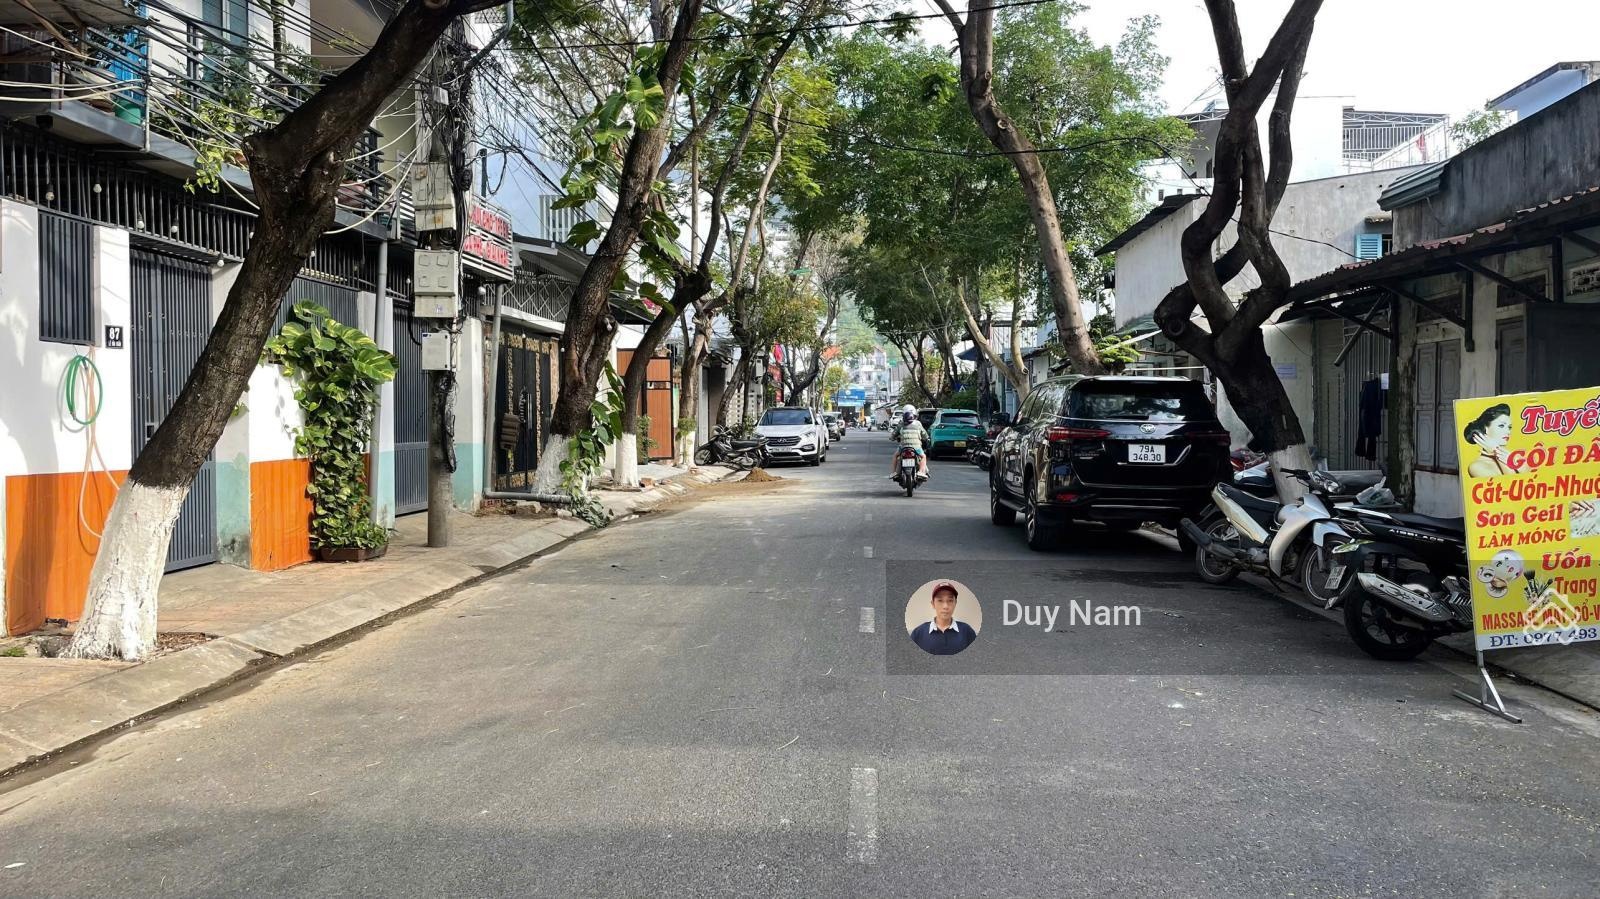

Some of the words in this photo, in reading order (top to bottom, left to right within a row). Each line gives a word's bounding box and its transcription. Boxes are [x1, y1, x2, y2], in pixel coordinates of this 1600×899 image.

[1133, 453, 1161, 462] 348.30
[1139, 445, 1155, 453] 79A
[1506, 441, 1557, 473] GỘI
[1476, 510, 1515, 528] Sơn
[1522, 504, 1564, 524] Geil
[1478, 531, 1514, 549] LÀM
[1517, 527, 1567, 545] MÓNG
[1542, 547, 1591, 571] Uốn
[1554, 576, 1597, 598] Trang
[1490, 634, 1519, 648] ĐT:
